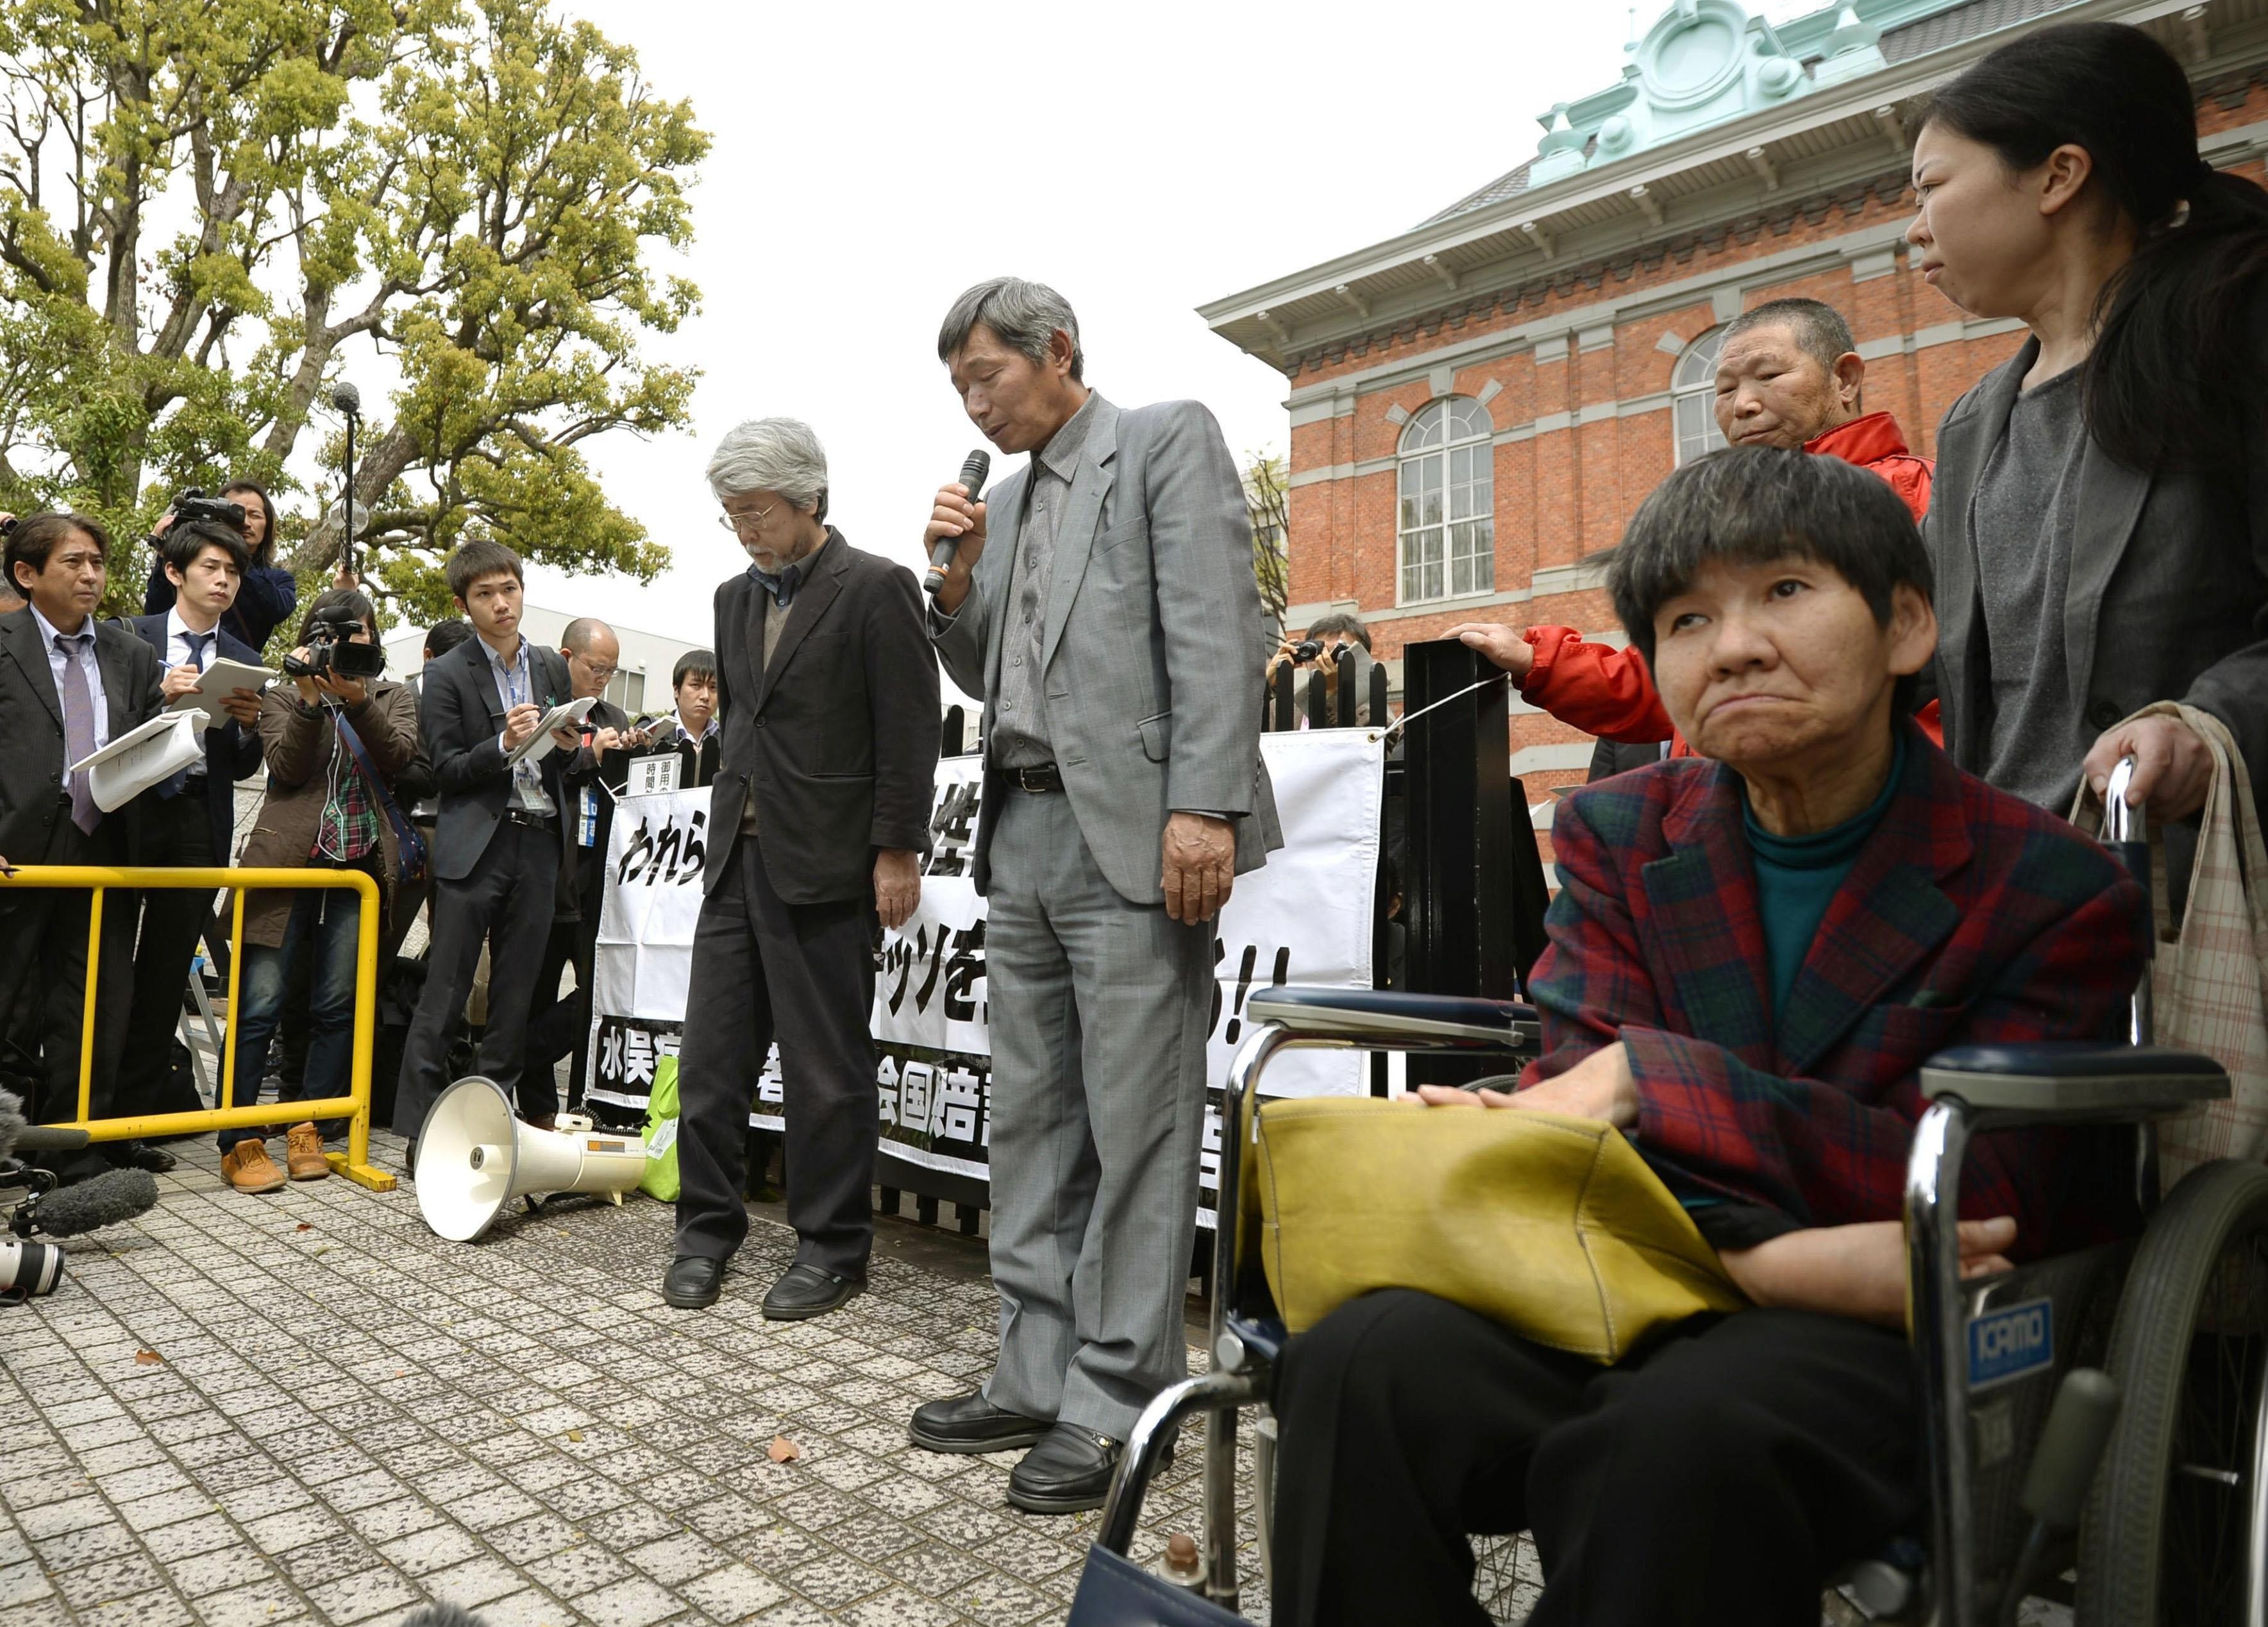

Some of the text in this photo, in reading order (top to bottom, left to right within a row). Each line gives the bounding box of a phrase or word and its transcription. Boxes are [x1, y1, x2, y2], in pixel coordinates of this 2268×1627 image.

[617, 810, 706, 886] われら
[877, 1055, 992, 1147] 会国賠
